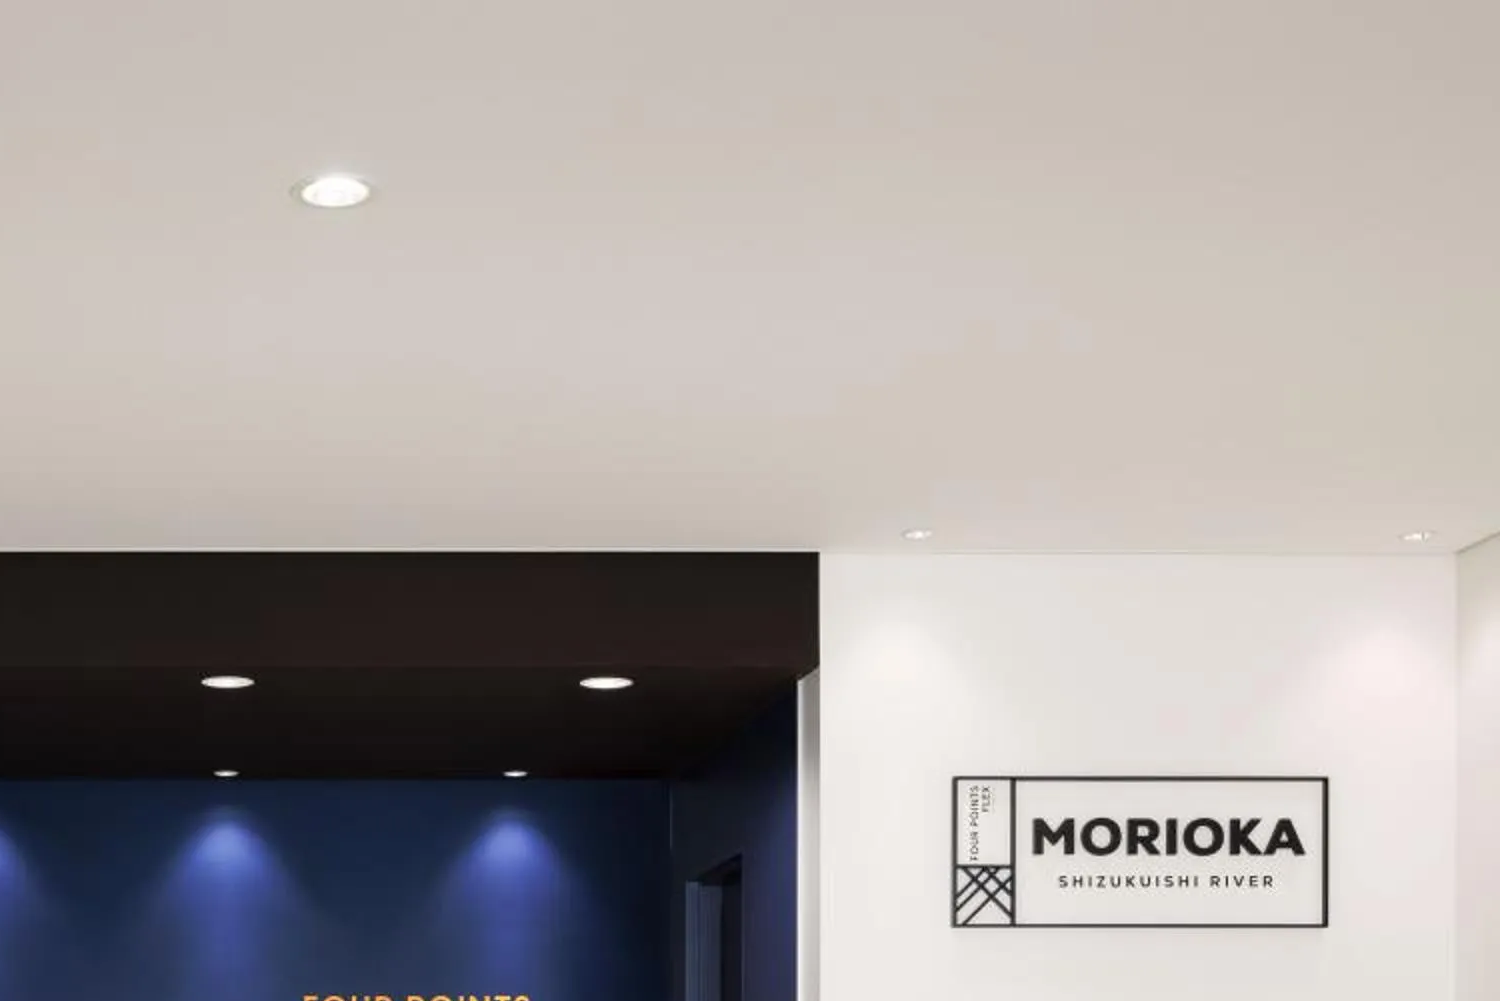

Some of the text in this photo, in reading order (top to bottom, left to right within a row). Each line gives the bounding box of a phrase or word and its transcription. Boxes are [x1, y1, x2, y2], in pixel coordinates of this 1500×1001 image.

[1031, 818, 1306, 856] MORIOKA
[1058, 875, 1274, 888] SHIZUKUISHI RIVER
